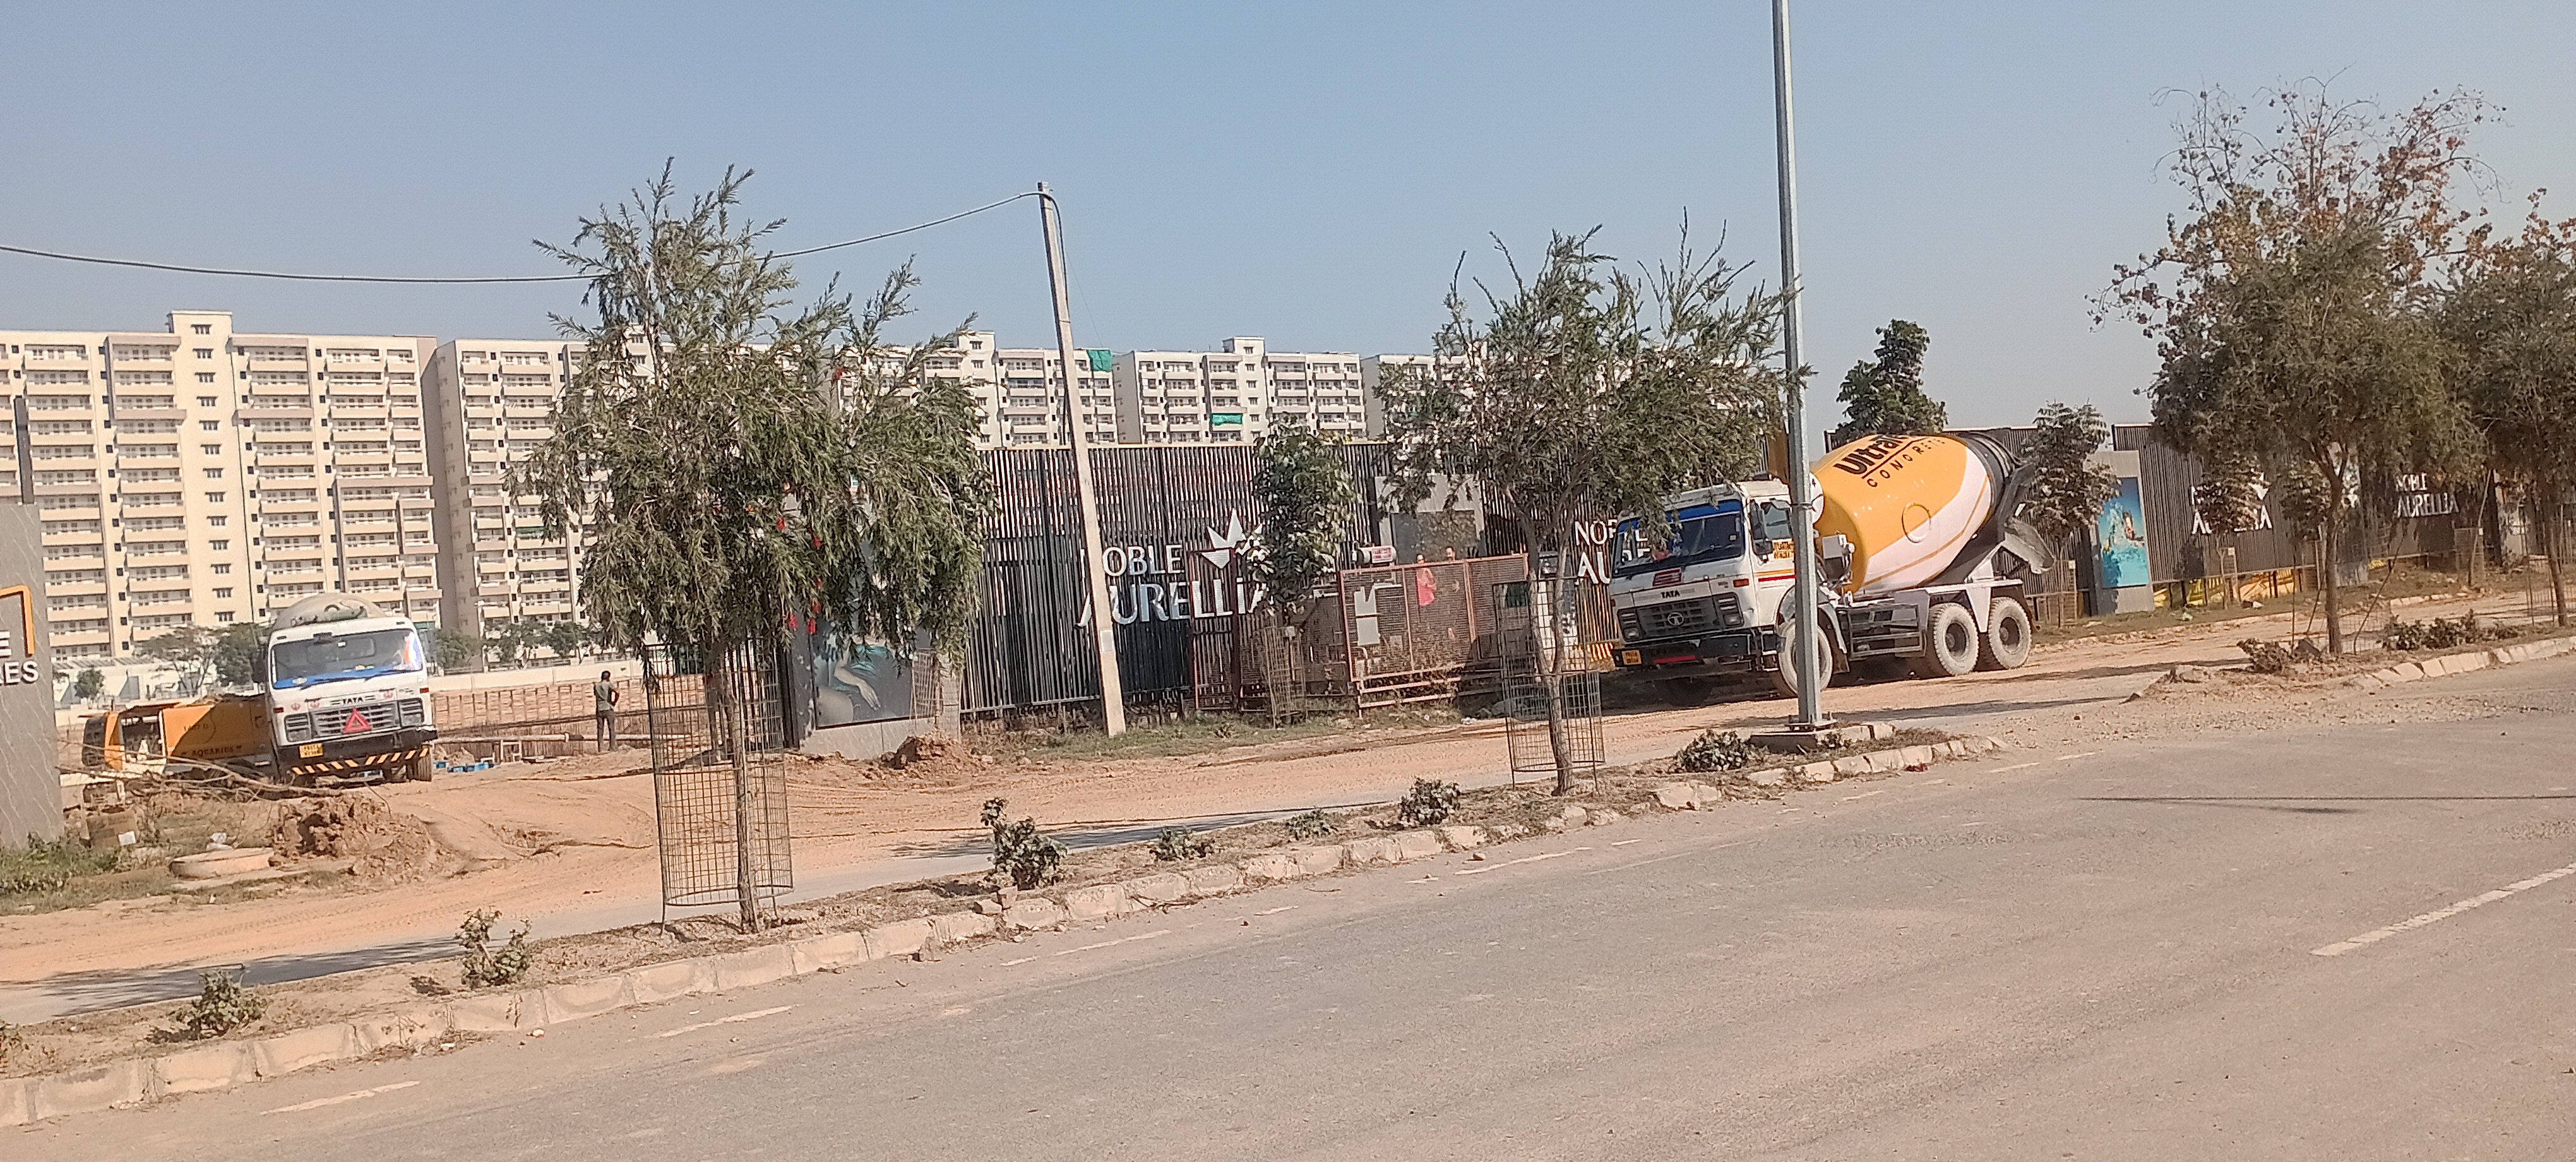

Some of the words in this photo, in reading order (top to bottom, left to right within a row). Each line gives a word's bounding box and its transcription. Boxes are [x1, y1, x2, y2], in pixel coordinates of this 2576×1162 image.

[1080, 544, 1186, 577] OBLE
[1075, 577, 1274, 627] URELLIA
[1661, 590, 1680, 599] TATA
[0, 661, 39, 683] ES
[342, 696, 364, 705] TATA
